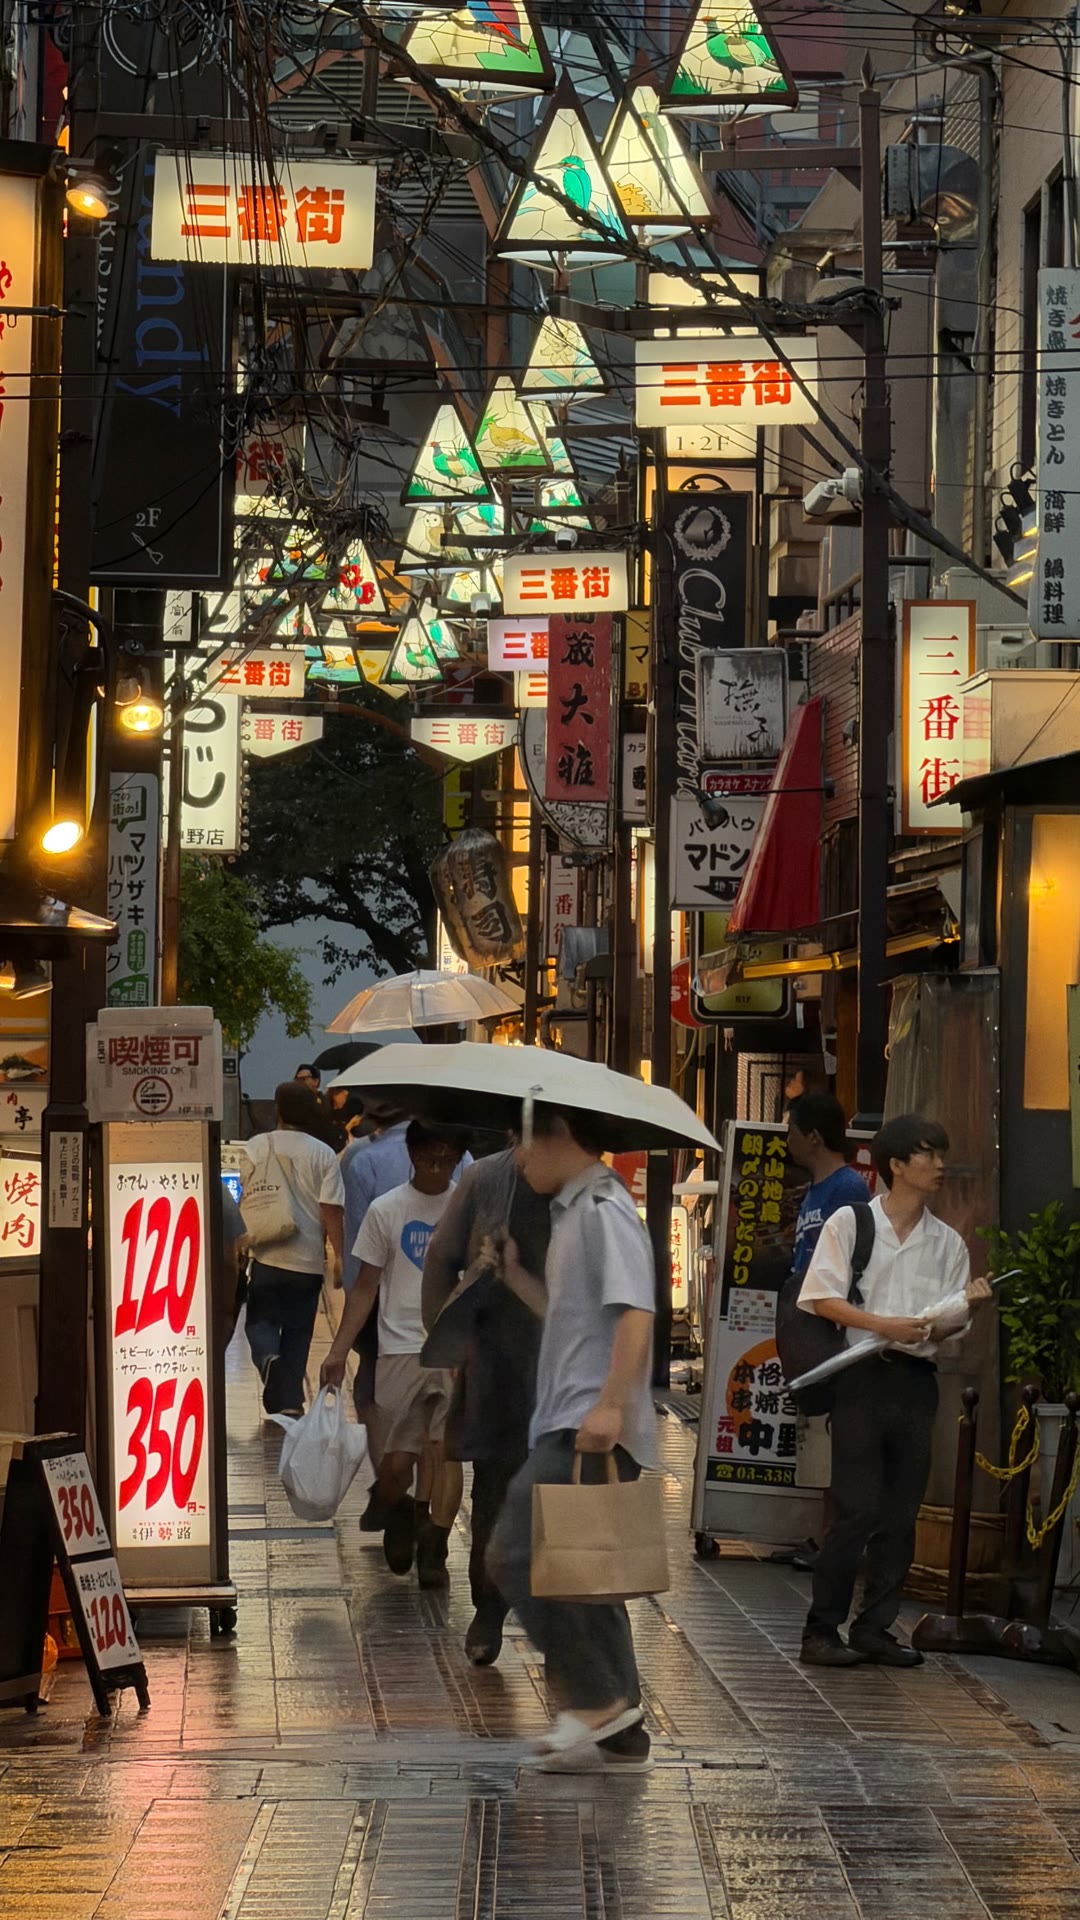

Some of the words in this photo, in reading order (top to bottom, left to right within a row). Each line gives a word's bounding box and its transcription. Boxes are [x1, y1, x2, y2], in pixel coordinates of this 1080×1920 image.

[181, 183, 345, 244] 三番街
[1045, 284, 1068, 350] 焼き鳥
[660, 360, 792, 407] 三番街
[1045, 376, 1067, 465] 焼きとん
[135, 507, 162, 528] 2F
[1043, 490, 1066, 534] 海鮮
[520, 566, 611, 600] 三番街
[1042, 557, 1066, 625] 鍋料理
[219, 660, 291, 687] 三番街
[558, 612, 596, 786] 蔵大雅
[430, 723, 505, 745] 三番街
[919, 634, 961, 804] 三番街
[709, 779, 740, 791] カラオケ
[180, 828, 225, 846] 野店
[127, 832, 147, 926] マツザキ
[107, 855, 124, 974] ハウジグ
[108, 1035, 203, 1067] 喫煙可
[122, 1066, 168, 1076] SMOKING
[170, 1066, 185, 1075] OK
[1, 1171, 41, 1248] 焼肉
[115, 1196, 200, 1339] 120
[733, 1359, 789, 1386] 本格
[118, 1376, 205, 1513] 350
[715, 1416, 735, 1454] 元祖
[57, 1483, 96, 1542] 350
[139, 1527, 192, 1541] 伊勢路
[91, 1593, 127, 1654] 120
